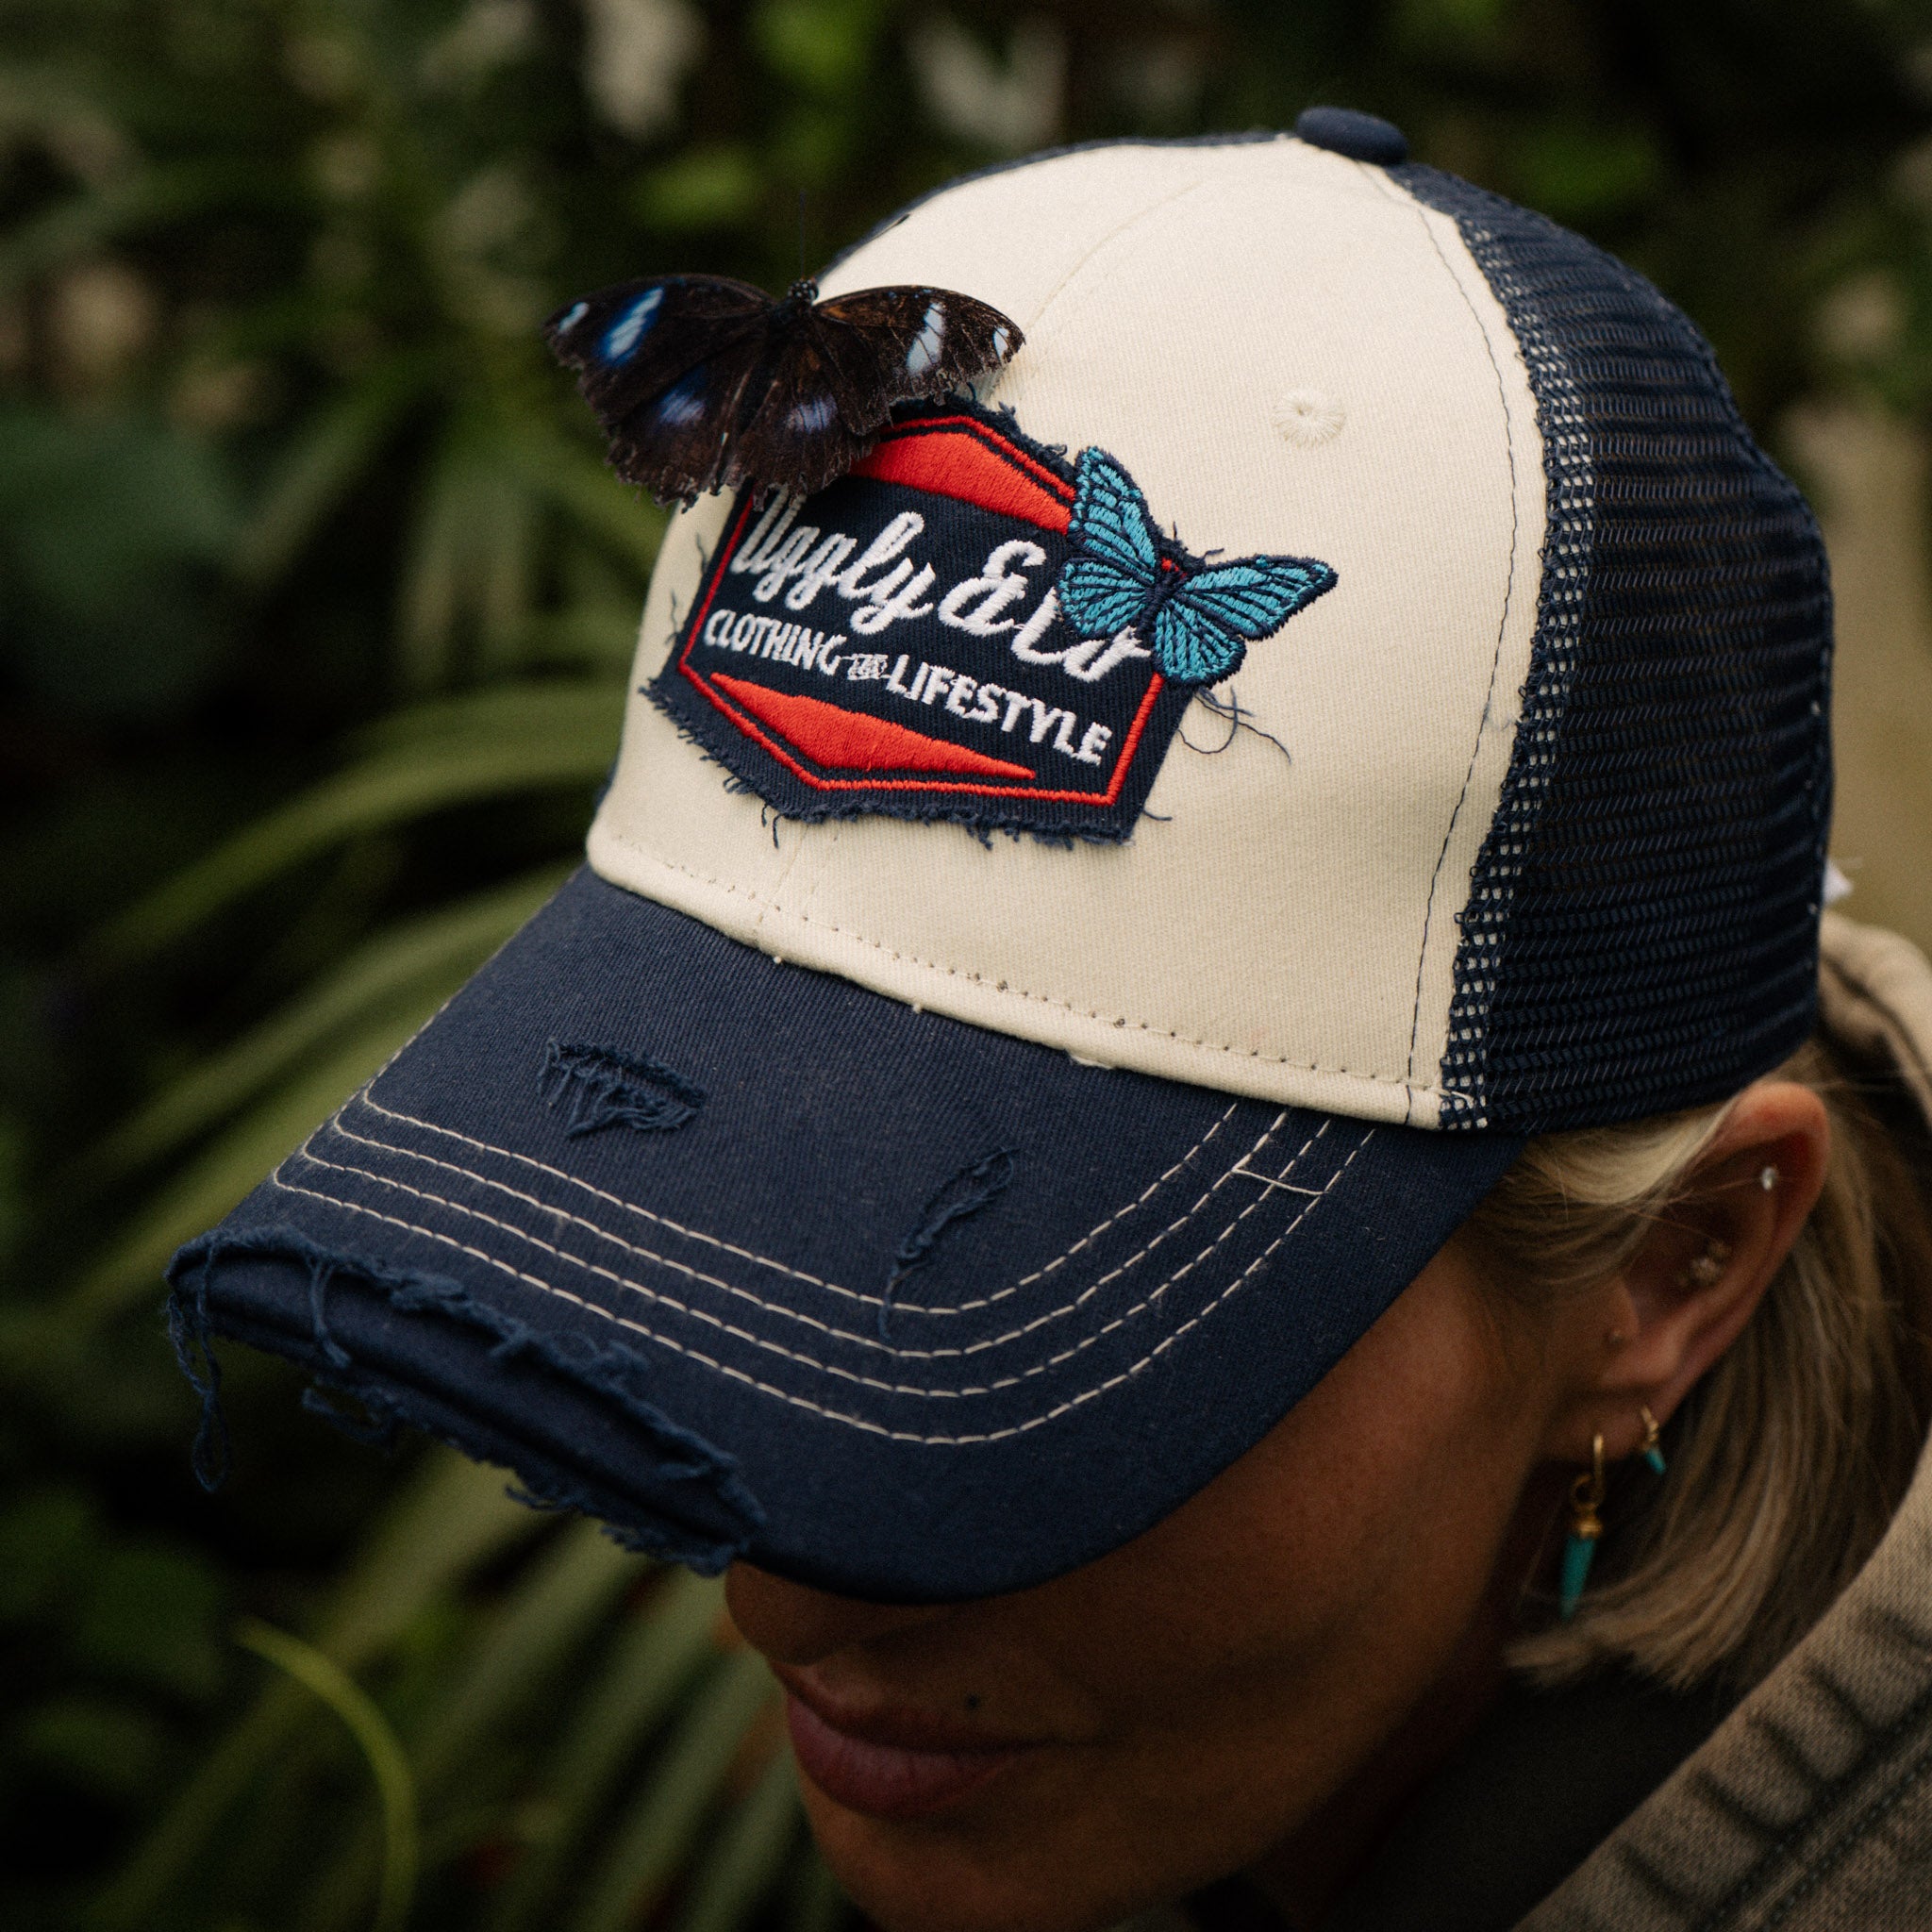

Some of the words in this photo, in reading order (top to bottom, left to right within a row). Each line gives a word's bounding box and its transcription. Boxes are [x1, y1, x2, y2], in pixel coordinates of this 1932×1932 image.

[937, 539, 1047, 637] &
[704, 608, 847, 675] CLOTHING
[886, 654, 1113, 767] LIFESTYLE
